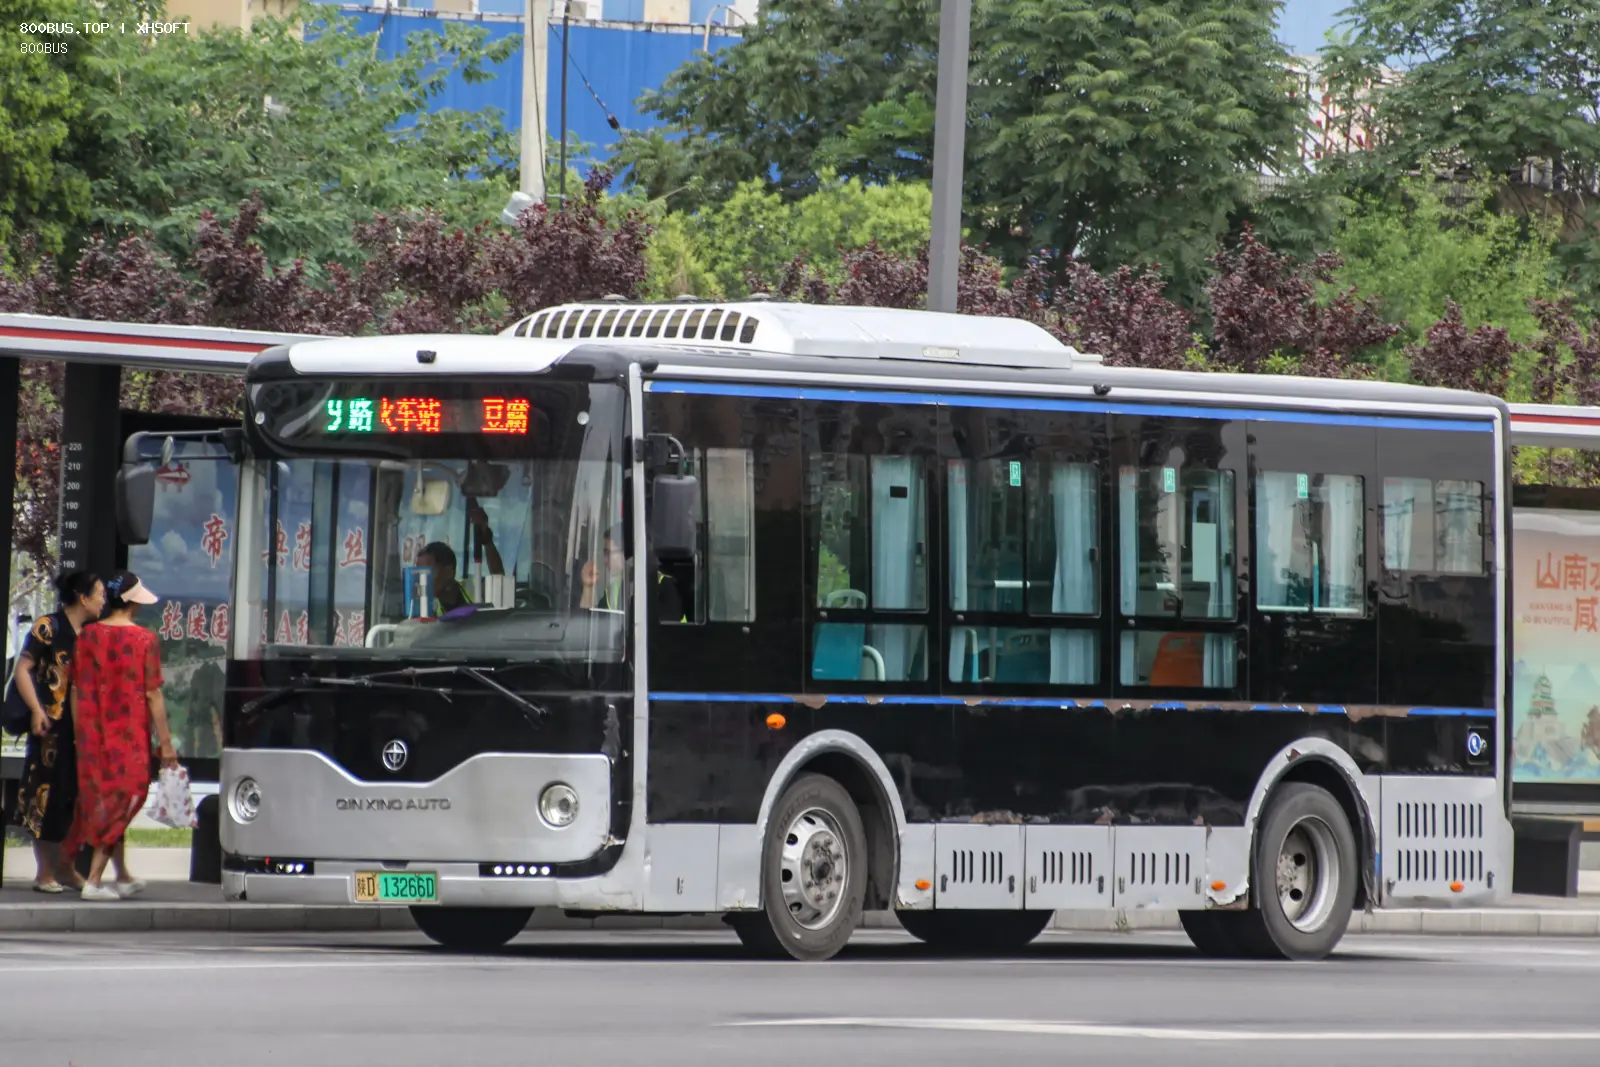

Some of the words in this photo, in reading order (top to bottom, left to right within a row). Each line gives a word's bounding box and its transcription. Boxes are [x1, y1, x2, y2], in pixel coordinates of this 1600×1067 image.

[69, 443, 82, 451] 220
[67, 462, 81, 471] 210
[66, 482, 80, 490] 200
[66, 502, 79, 510] 190
[65, 521, 78, 530] 180
[64, 541, 76, 549] 170
[336, 798, 363, 811] QIN
[406, 798, 451, 811] AUTO
[383, 876, 435, 898] 13266D
